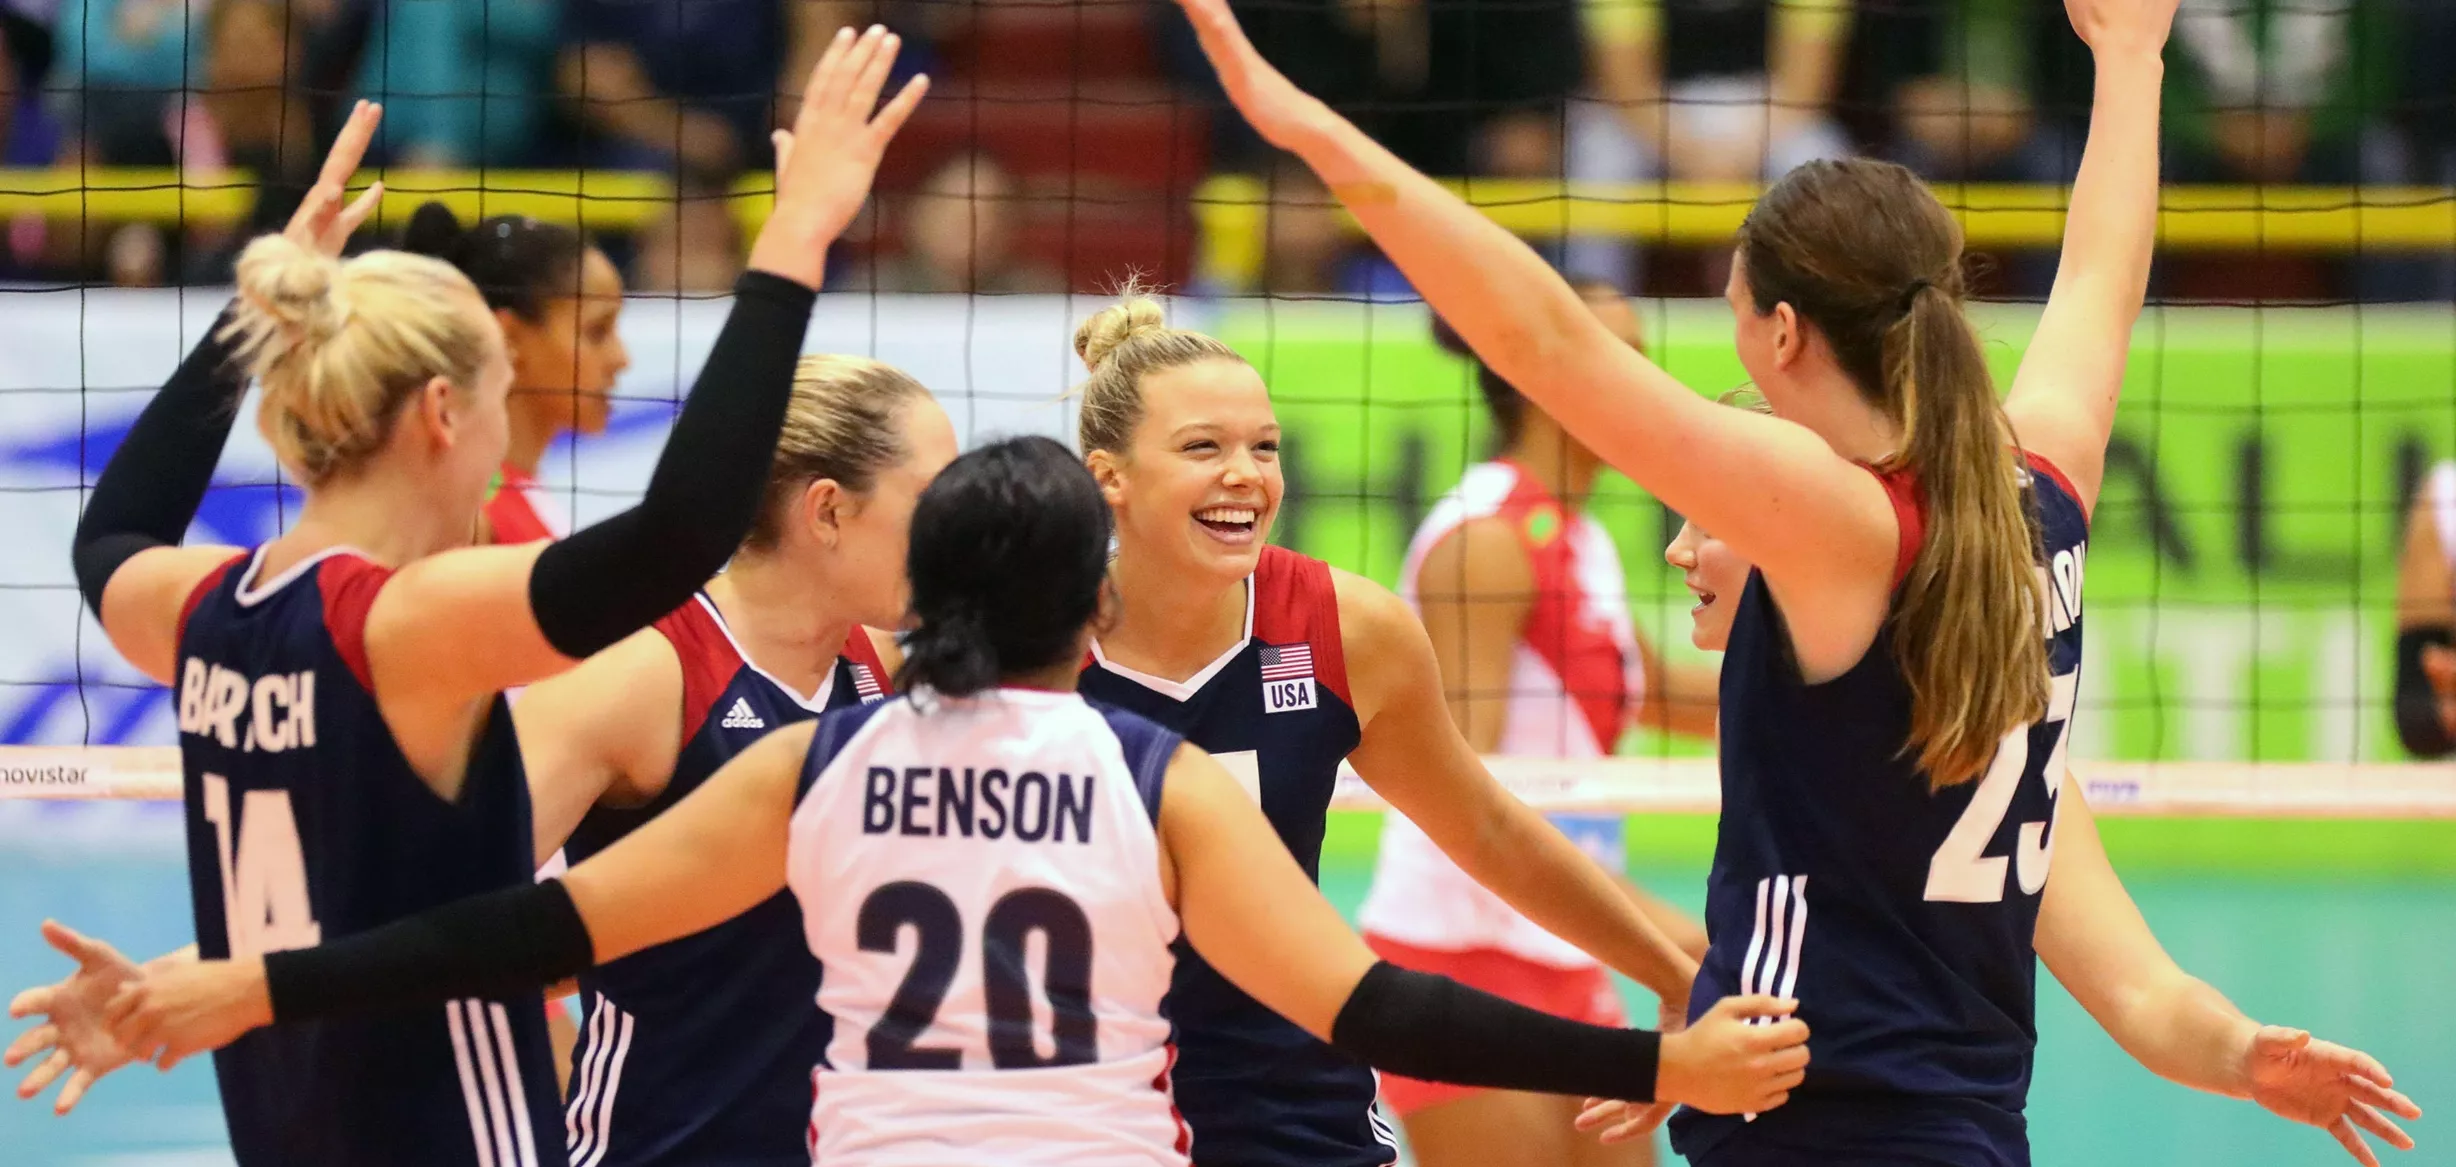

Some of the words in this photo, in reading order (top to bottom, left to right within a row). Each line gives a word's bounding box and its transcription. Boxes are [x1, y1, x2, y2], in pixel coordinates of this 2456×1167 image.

[179, 656, 316, 753] BARCH
[721, 715, 765, 729] adidas
[1271, 682, 1310, 709] USA
[862, 766, 1095, 843] BENSON
[1923, 662, 2079, 902] 23
[202, 771, 321, 961] 14
[856, 880, 1101, 1071] 20
